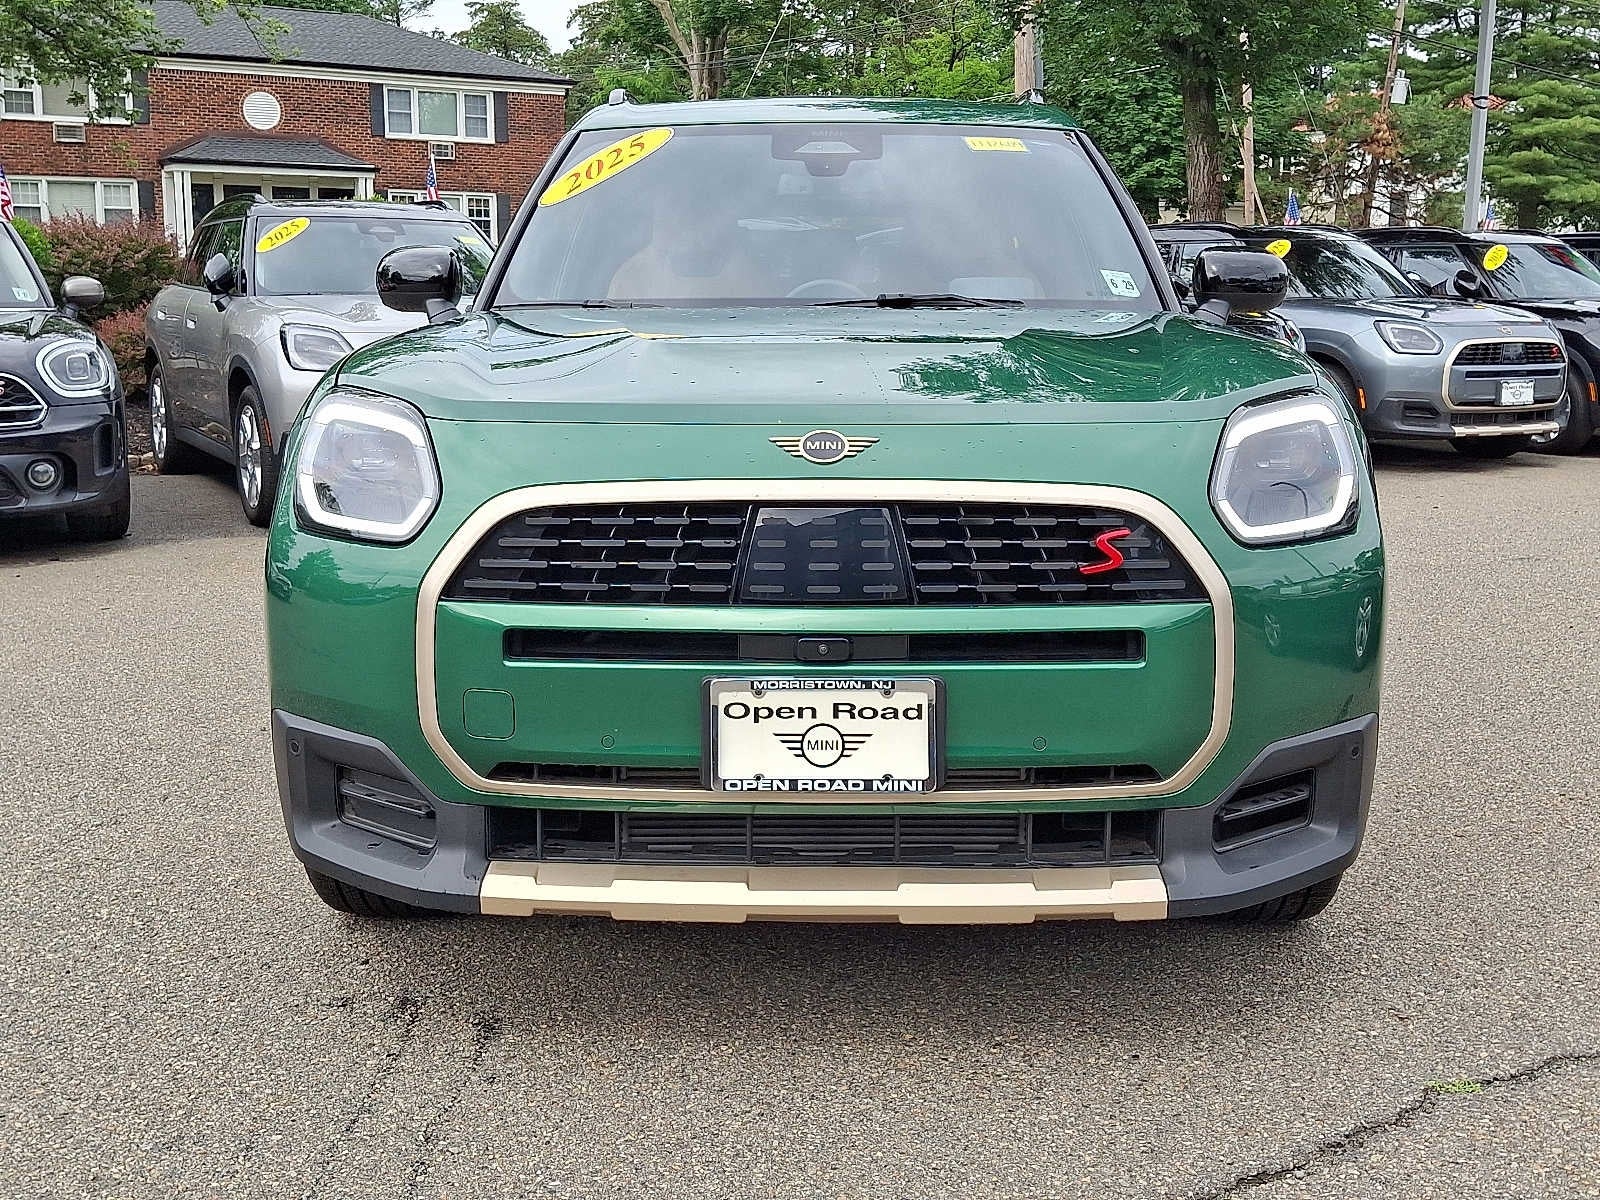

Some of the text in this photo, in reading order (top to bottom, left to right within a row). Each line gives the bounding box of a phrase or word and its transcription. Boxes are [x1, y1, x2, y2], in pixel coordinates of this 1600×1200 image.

[565, 134, 645, 195] 2025
[267, 221, 300, 247] 2025
[1110, 278, 1135, 291] 6 29
[806, 440, 842, 450] MINI
[1079, 527, 1131, 575] S
[871, 681, 892, 689] NJ
[723, 702, 923, 724] Open Road
[806, 739, 840, 751] MINI
[724, 779, 924, 791] OPEN ROAD MINI
